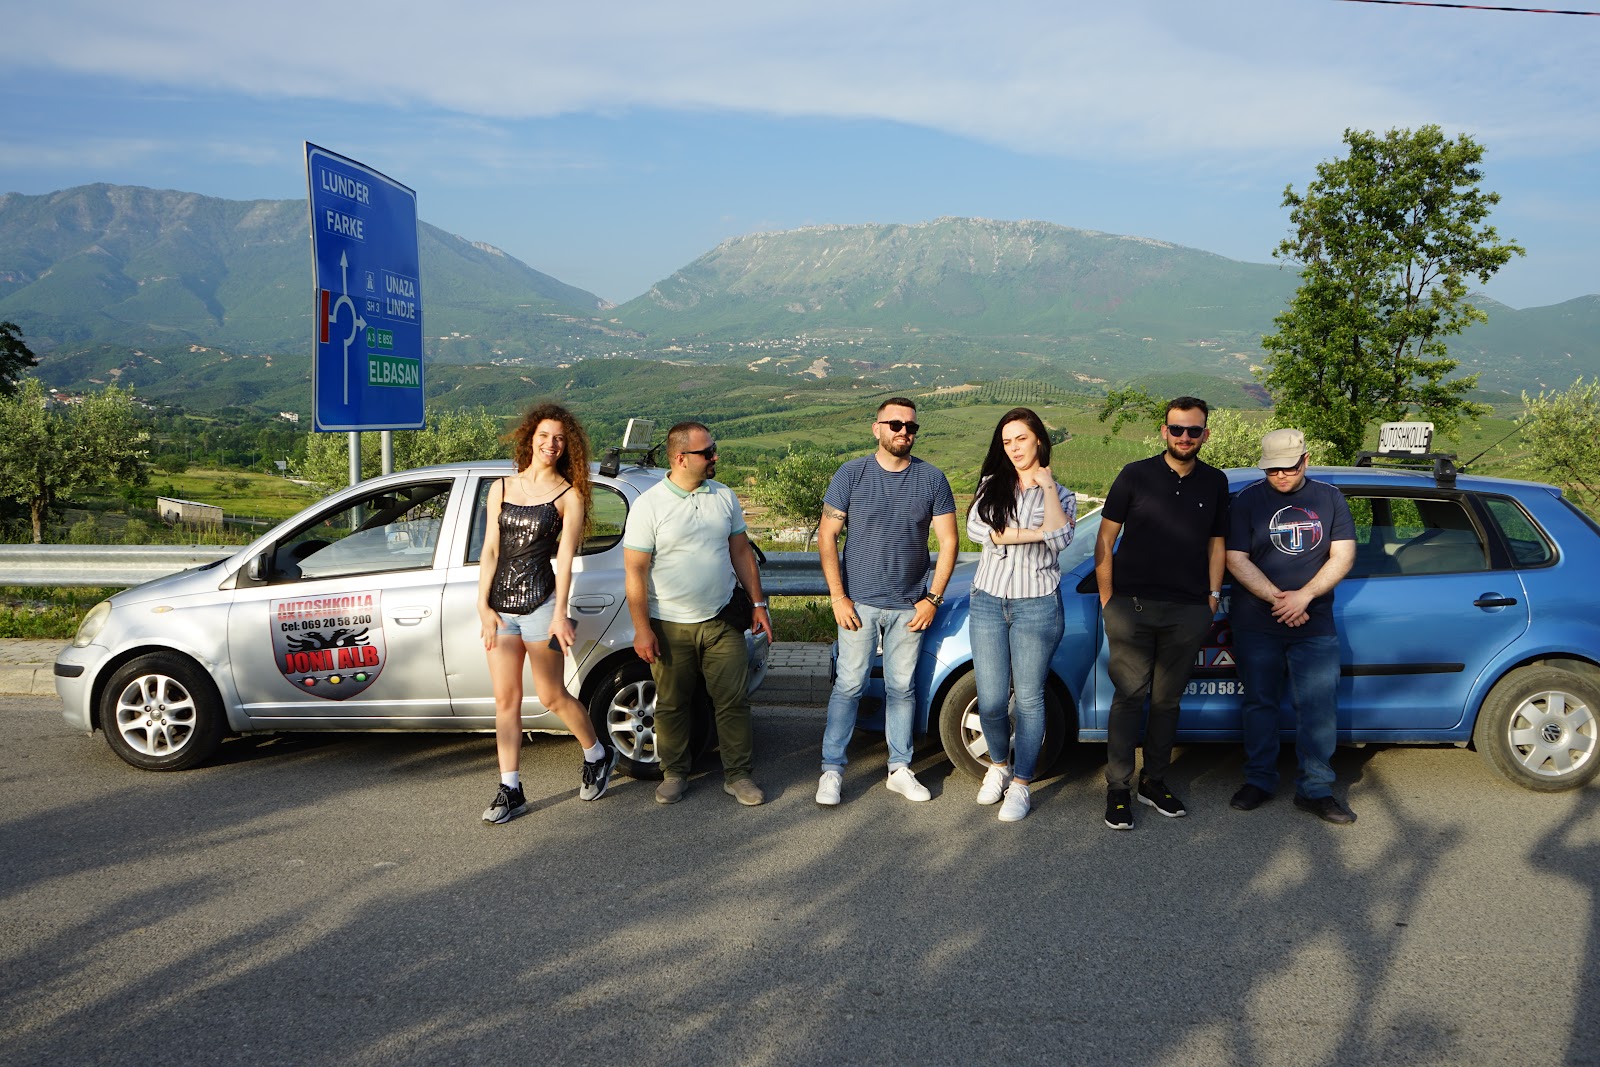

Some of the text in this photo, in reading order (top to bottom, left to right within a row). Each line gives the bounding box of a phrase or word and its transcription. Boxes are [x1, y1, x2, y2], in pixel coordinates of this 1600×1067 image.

[321, 169, 370, 205] LUNDER
[326, 210, 364, 240] FARKE
[386, 274, 415, 299] UNAZA
[386, 297, 415, 320] LINDJE
[369, 360, 419, 386] ELBASAN
[1380, 427, 1429, 448] AUTOSHKOLLE
[277, 595, 373, 616] AUTOSHKOLLA
[281, 614, 372, 632] Cel: 069 20 58 200
[285, 646, 379, 674] JONI ALB
[1200, 682, 1216, 695] 20
[1218, 681, 1235, 695] 58
[1237, 681, 1245, 695] 2
